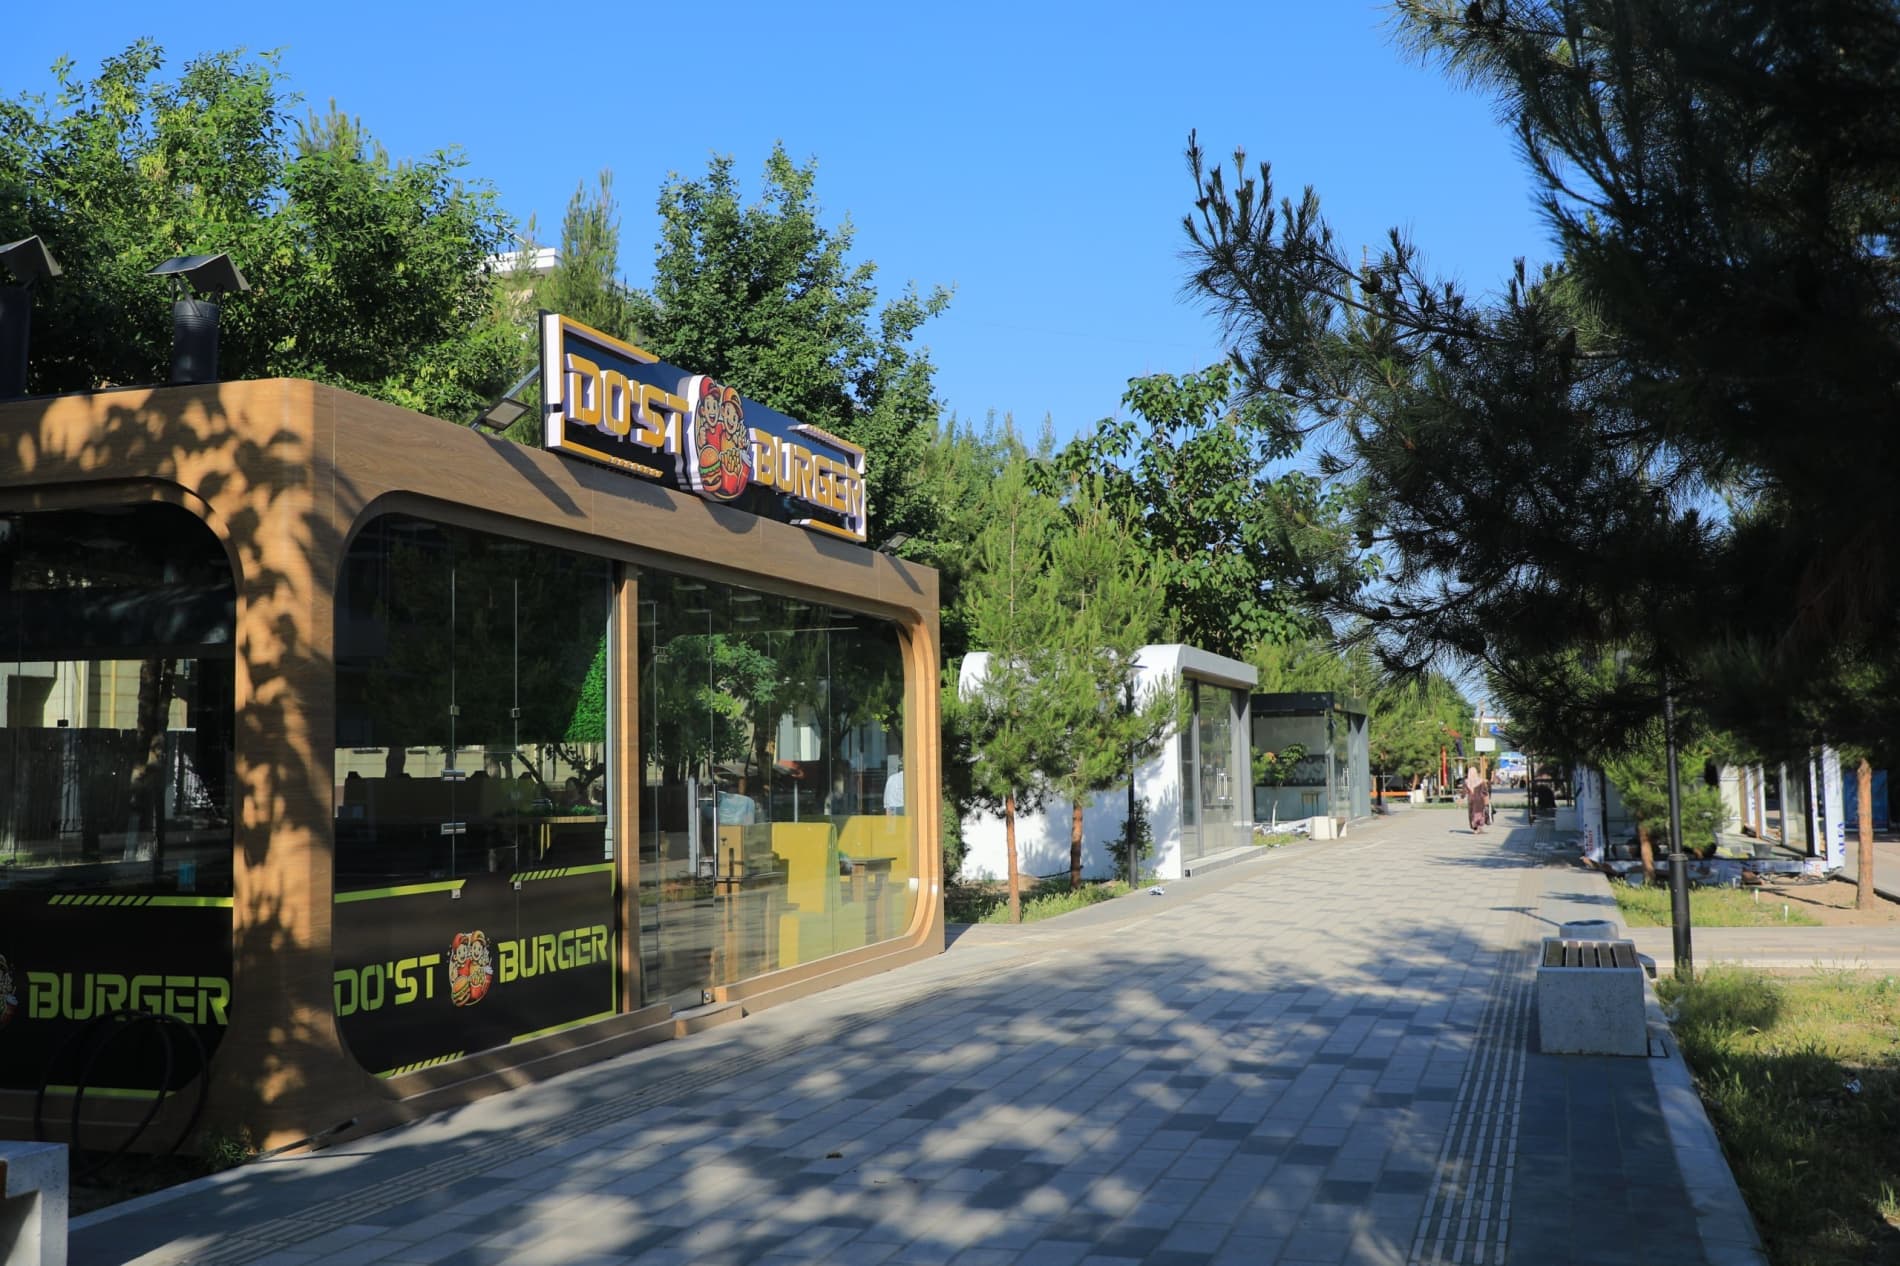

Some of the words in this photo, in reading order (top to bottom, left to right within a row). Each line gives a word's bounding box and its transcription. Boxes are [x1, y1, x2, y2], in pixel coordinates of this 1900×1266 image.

[564, 353, 690, 456] DO'ST
[749, 427, 863, 517] BURGER
[26, 971, 230, 1025] BURGER
[333, 953, 440, 1016] DO'ST
[498, 924, 608, 983] BURGER
